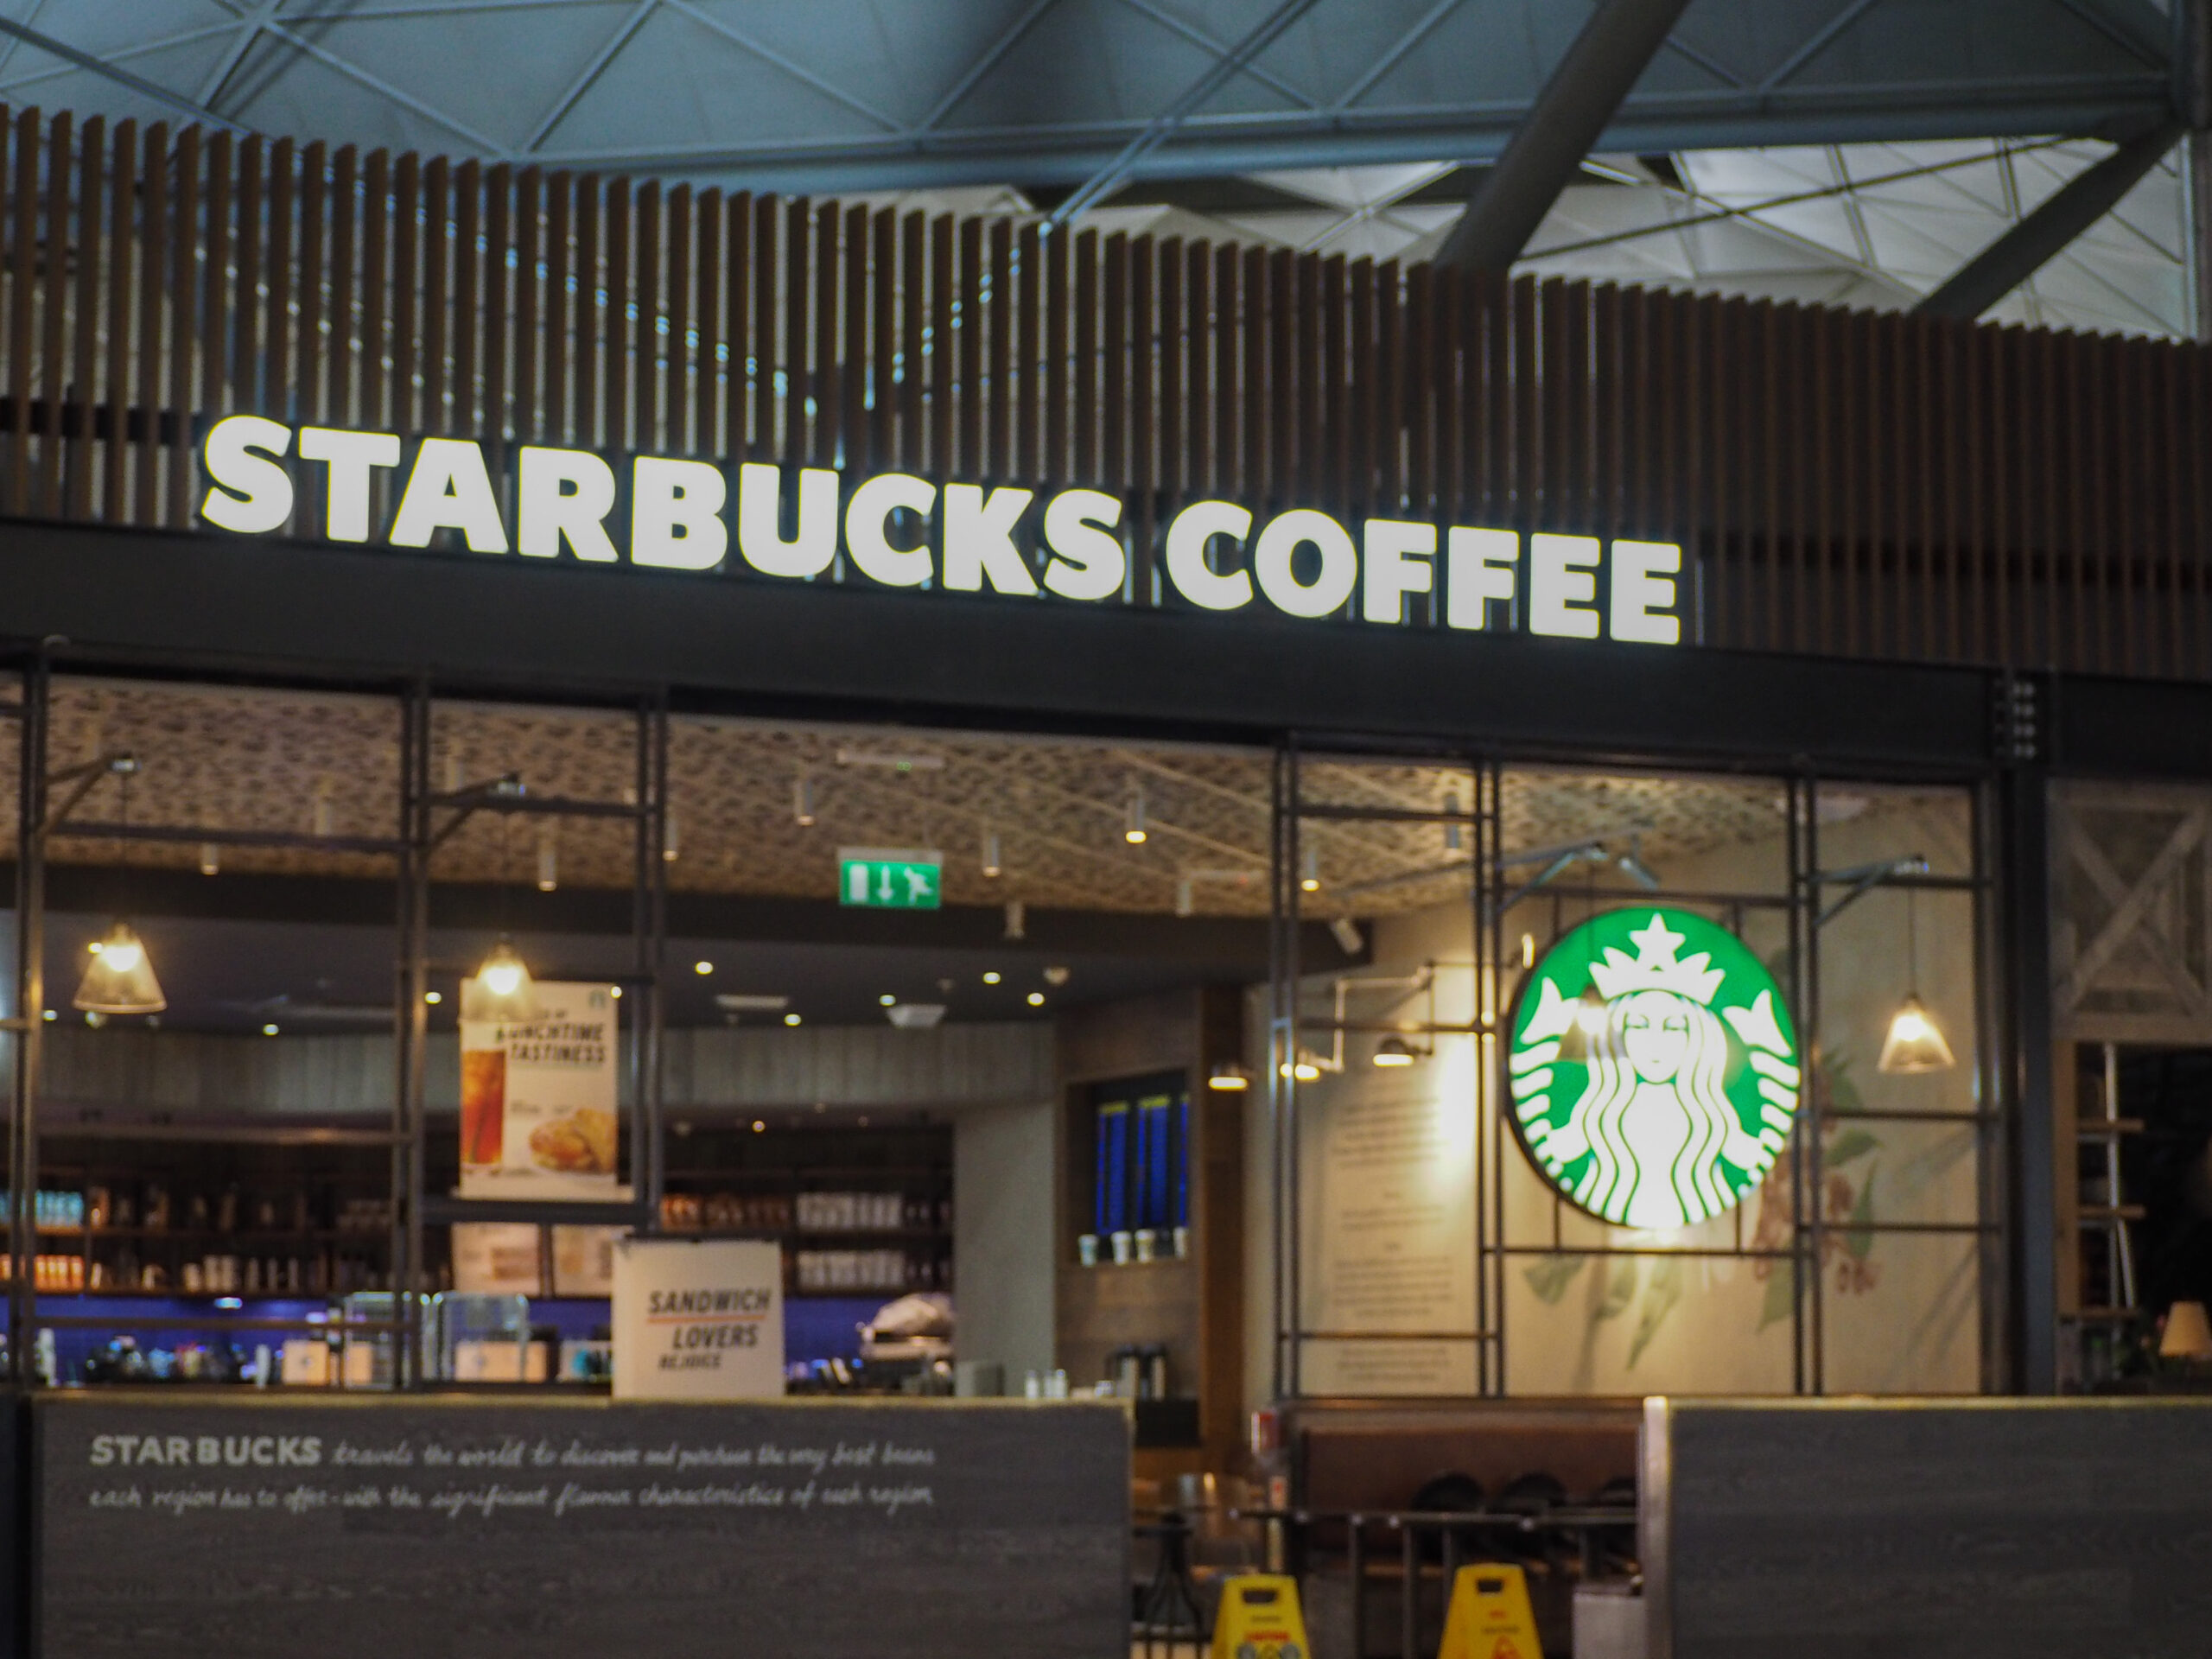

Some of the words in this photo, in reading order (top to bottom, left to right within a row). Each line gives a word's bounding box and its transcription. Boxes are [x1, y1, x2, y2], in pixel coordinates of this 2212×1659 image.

[201, 415, 1126, 601] STARBUCKS
[1166, 500, 1681, 645] COFFEE
[511, 1043, 605, 1062] TASTINESS
[649, 1287, 771, 1313] SANDWICH
[672, 1325, 758, 1349] LOVERS
[90, 1434, 321, 1465] STARBUCKS
[423, 1443, 452, 1465] the
[457, 1438, 524, 1466] world
[531, 1438, 556, 1465] to
[560, 1439, 640, 1465] discover
[757, 1442, 785, 1465] the
[831, 1440, 876, 1466] best
[89, 1485, 141, 1507] each
[152, 1483, 215, 1516] region
[257, 1488, 276, 1508] to
[388, 1485, 421, 1508] the
[429, 1481, 547, 1518] significant
[790, 1480, 816, 1509] of
